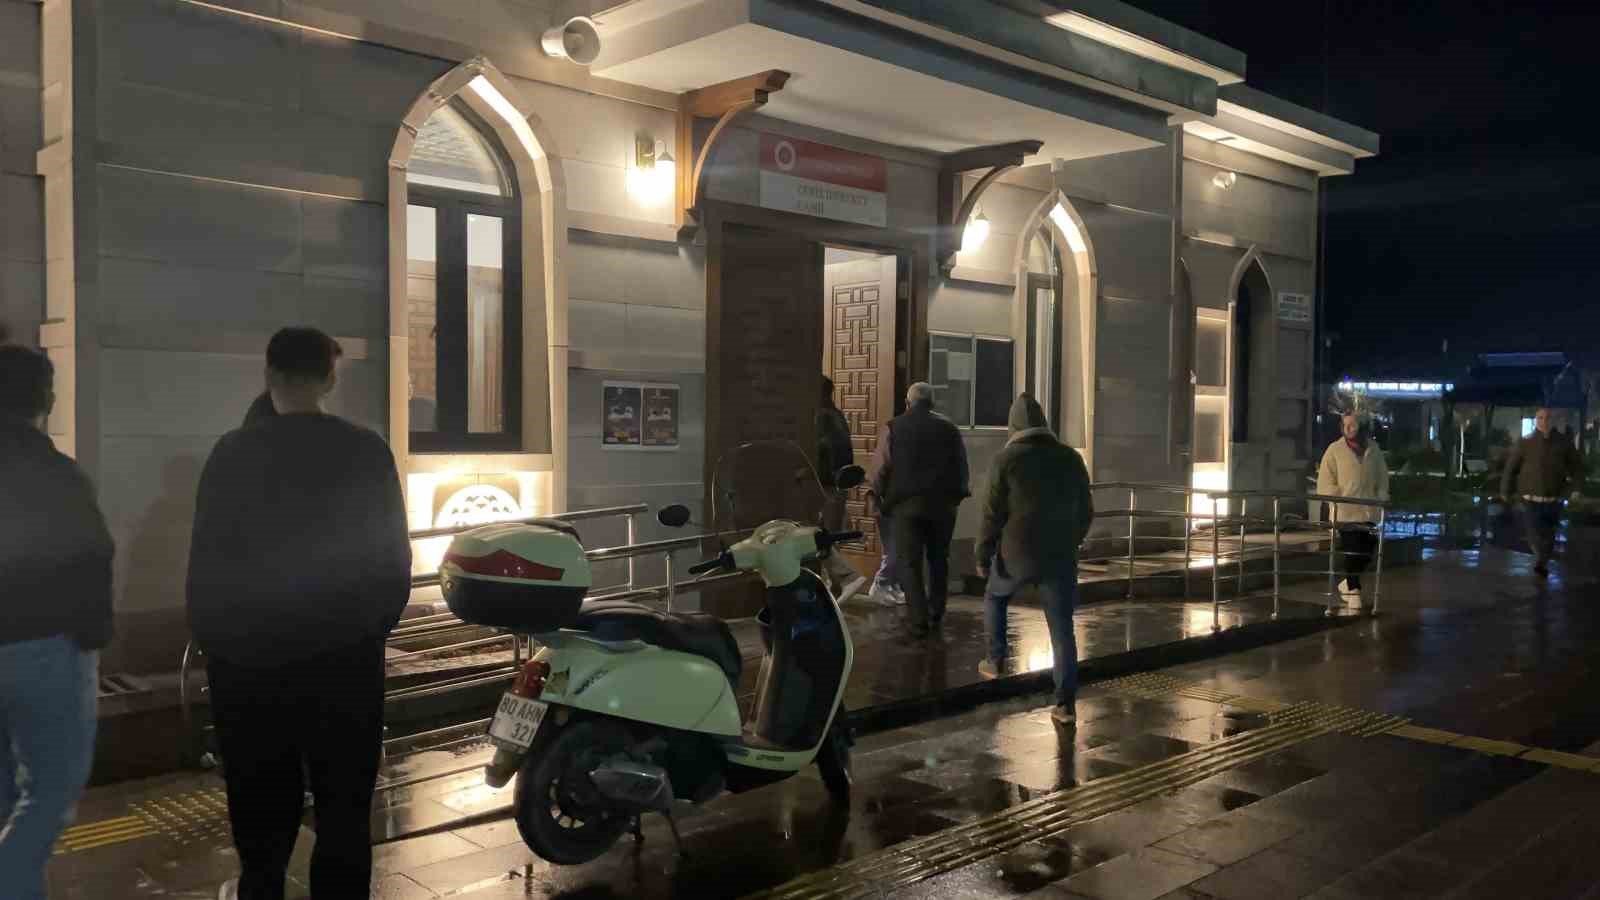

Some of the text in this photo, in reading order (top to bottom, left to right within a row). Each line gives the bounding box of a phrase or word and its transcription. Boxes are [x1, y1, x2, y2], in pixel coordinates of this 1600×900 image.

[499, 696, 545, 723] 80 AHN
[512, 722, 535, 743] 321
